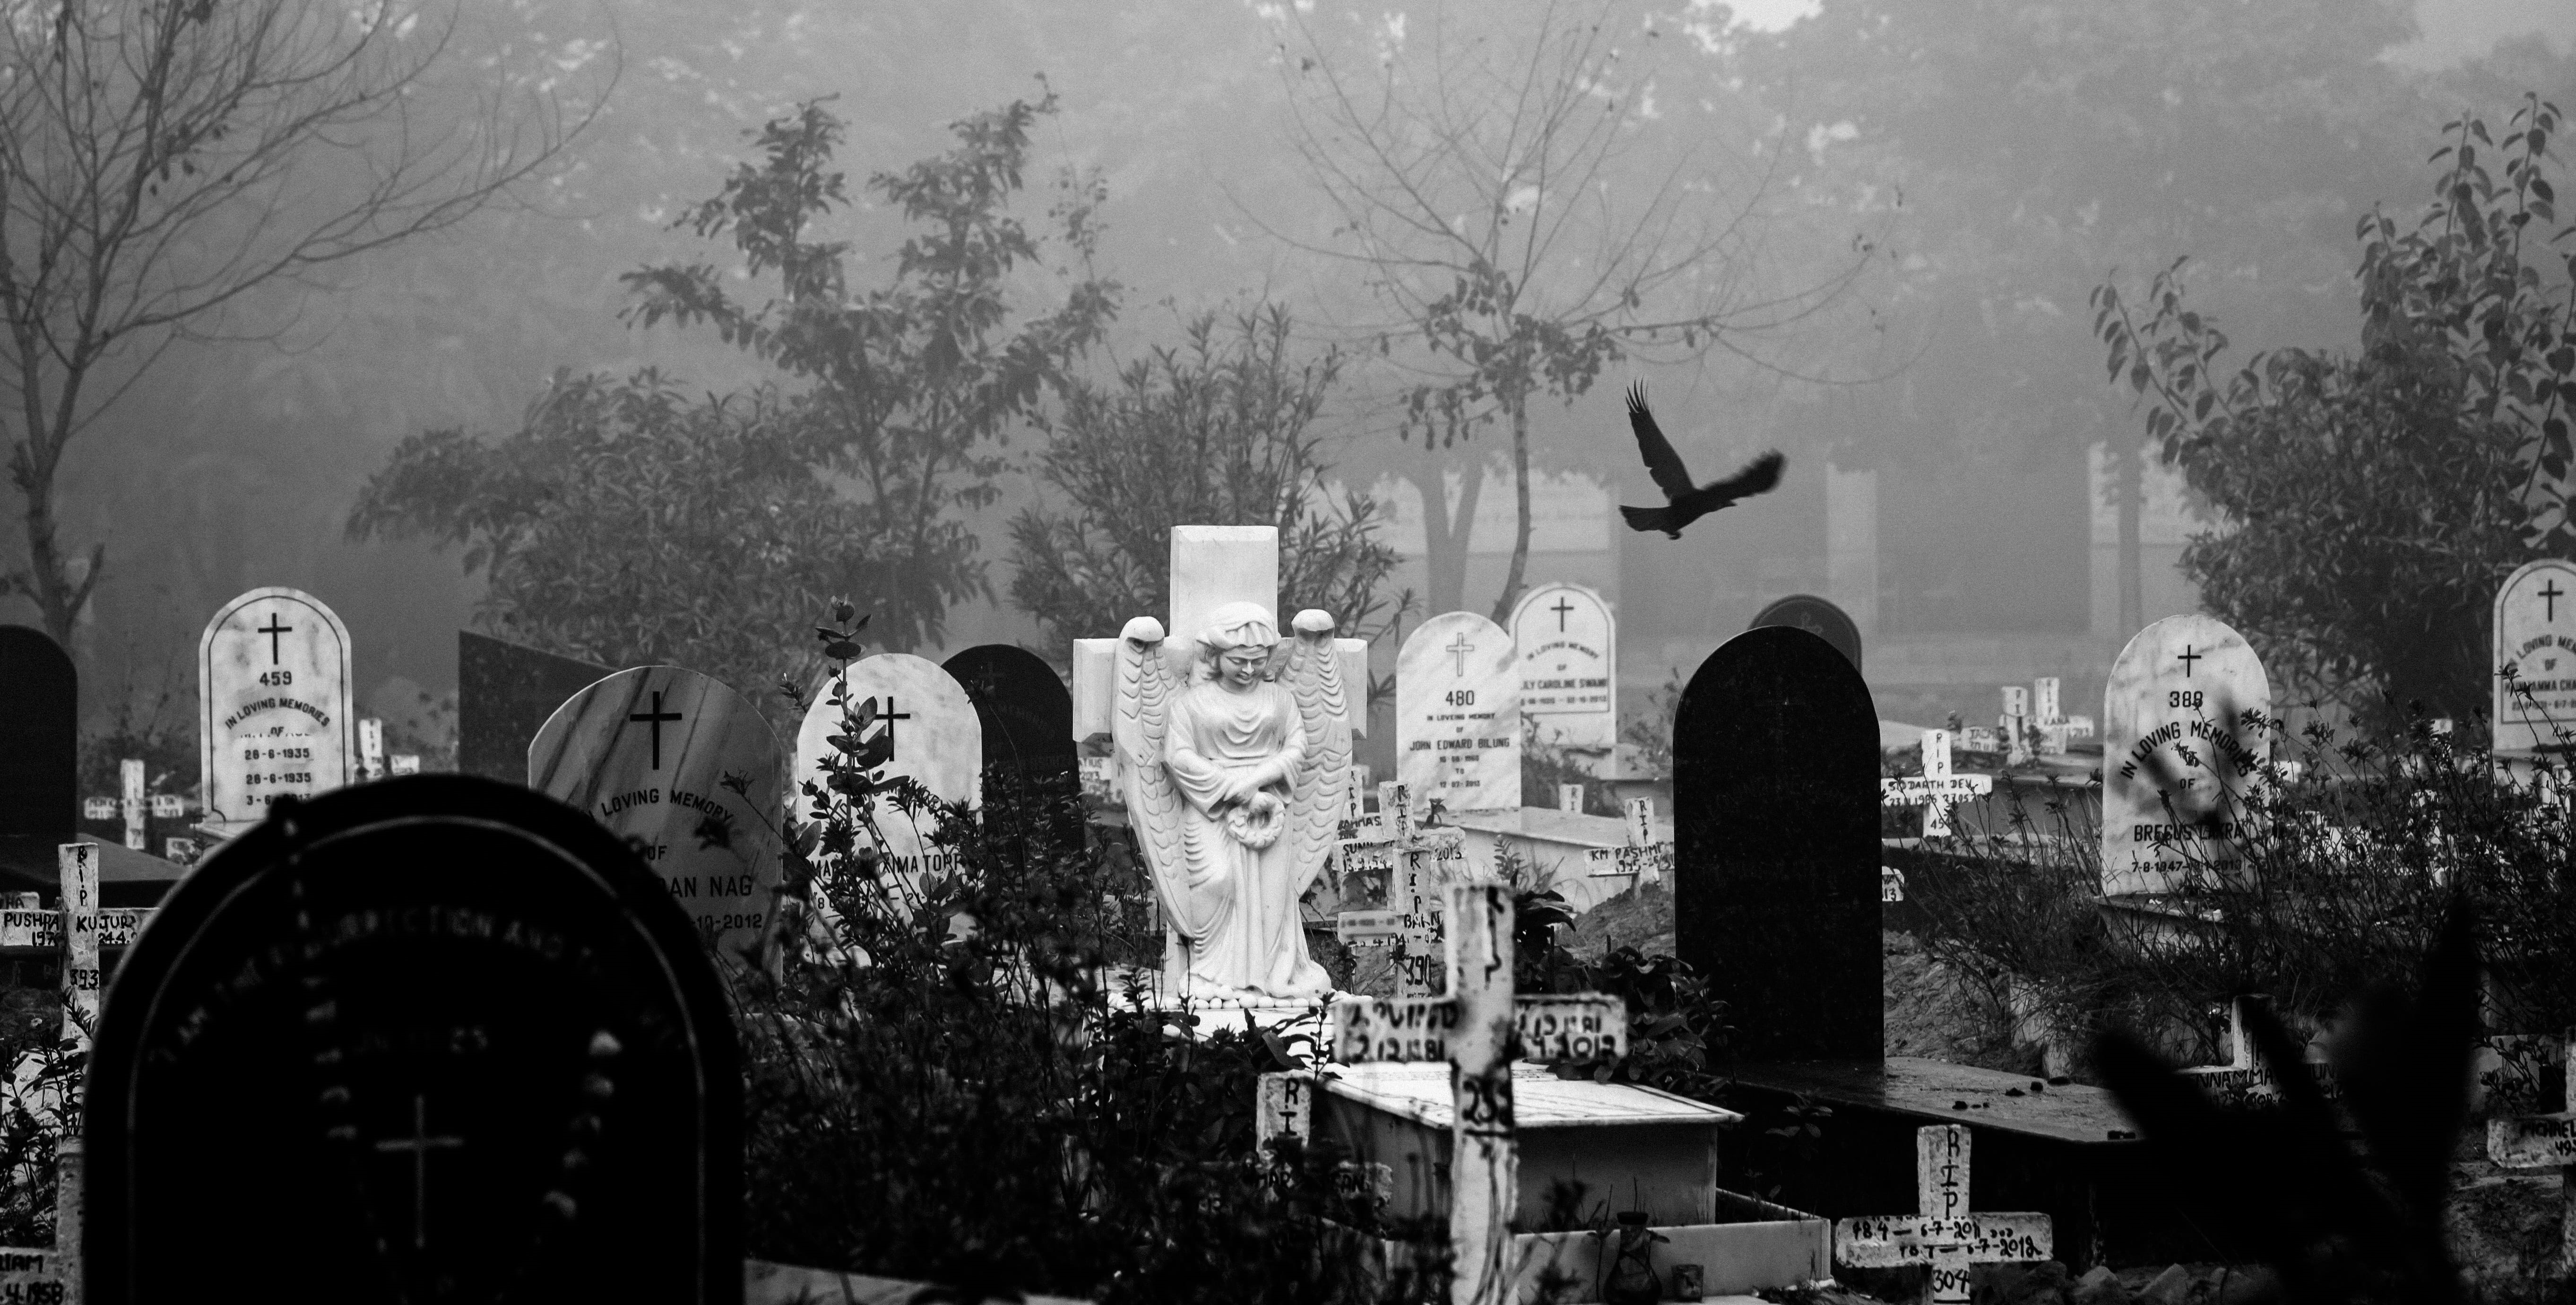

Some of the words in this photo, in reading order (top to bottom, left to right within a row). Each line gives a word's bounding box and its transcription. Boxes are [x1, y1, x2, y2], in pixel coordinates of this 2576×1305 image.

[259, 671, 292, 686] 459
[1445, 690, 1474, 706] 480
[225, 716, 237, 730] IN
[237, 697, 276, 720] LOVING
[279, 697, 329, 727] MEMORIES
[1409, 740, 1431, 751] JOHN
[1437, 739, 1472, 750] EDWARD
[2120, 760, 2137, 780] IN
[2132, 722, 2180, 762] LOVING
[2191, 720, 2248, 777] MEMORIS
[2180, 778, 2196, 789] OF
[601, 788, 659, 817] LOVING
[670, 790, 734, 823] MEMORY
[710, 876, 752, 897] NAG
[70, 969, 99, 990] 393
[1932, 1269, 1971, 1294] 304
